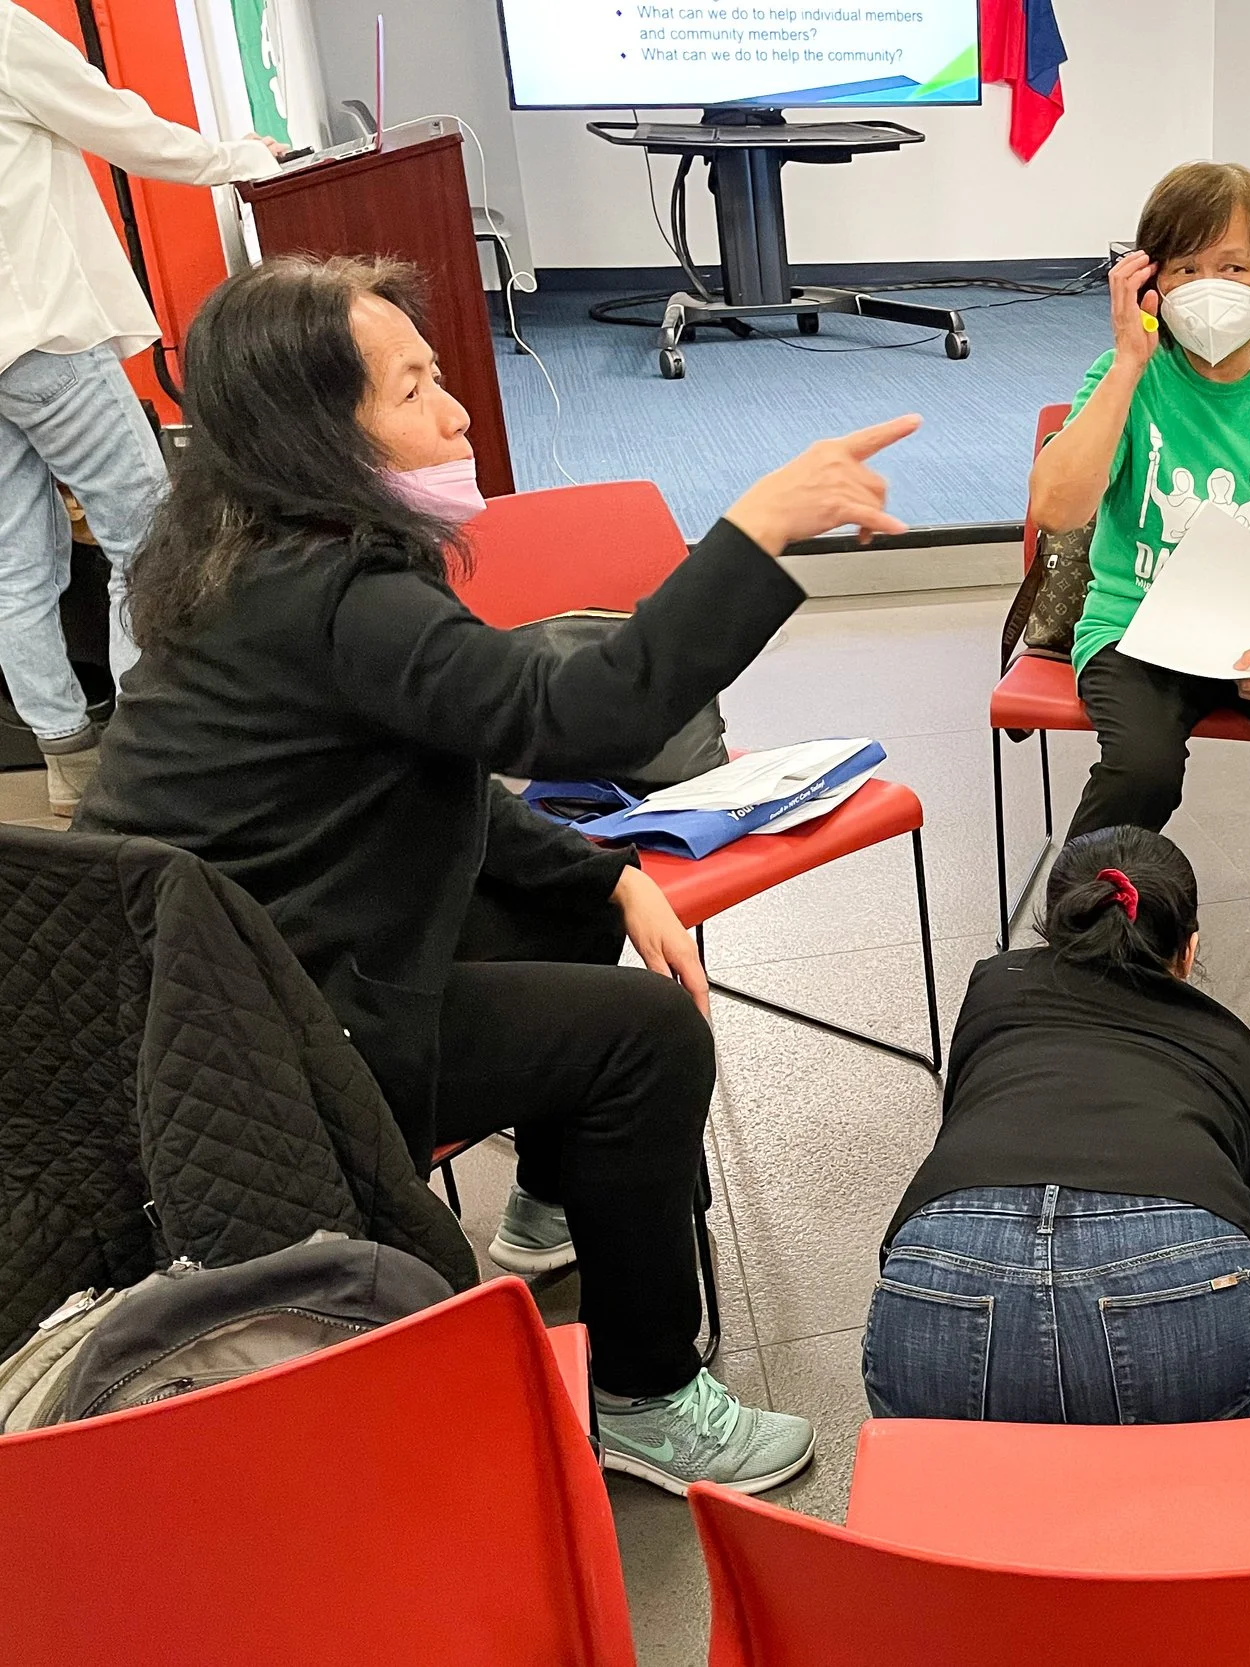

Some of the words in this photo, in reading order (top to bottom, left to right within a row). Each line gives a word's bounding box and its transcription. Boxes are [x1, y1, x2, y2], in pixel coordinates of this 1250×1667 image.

[637, 5, 674, 19] What
[678, 9, 703, 19] can
[707, 9, 727, 19] we
[731, 7, 748, 20] do
[752, 8, 765, 20] to
[769, 8, 797, 22] help
[801, 8, 861, 22] individual
[865, 10, 923, 22] members
[639, 27, 665, 40] and
[670, 29, 744, 44] community
[748, 28, 817, 41] members?
[641, 48, 678, 61] What
[682, 51, 706, 61] can
[711, 51, 730, 61] we
[734, 49, 751, 61] do
[755, 50, 768, 61] to
[772, 49, 800, 63] help
[803, 50, 824, 62] the
[827, 48, 903, 64] community?
[727, 804, 756, 821] Your
